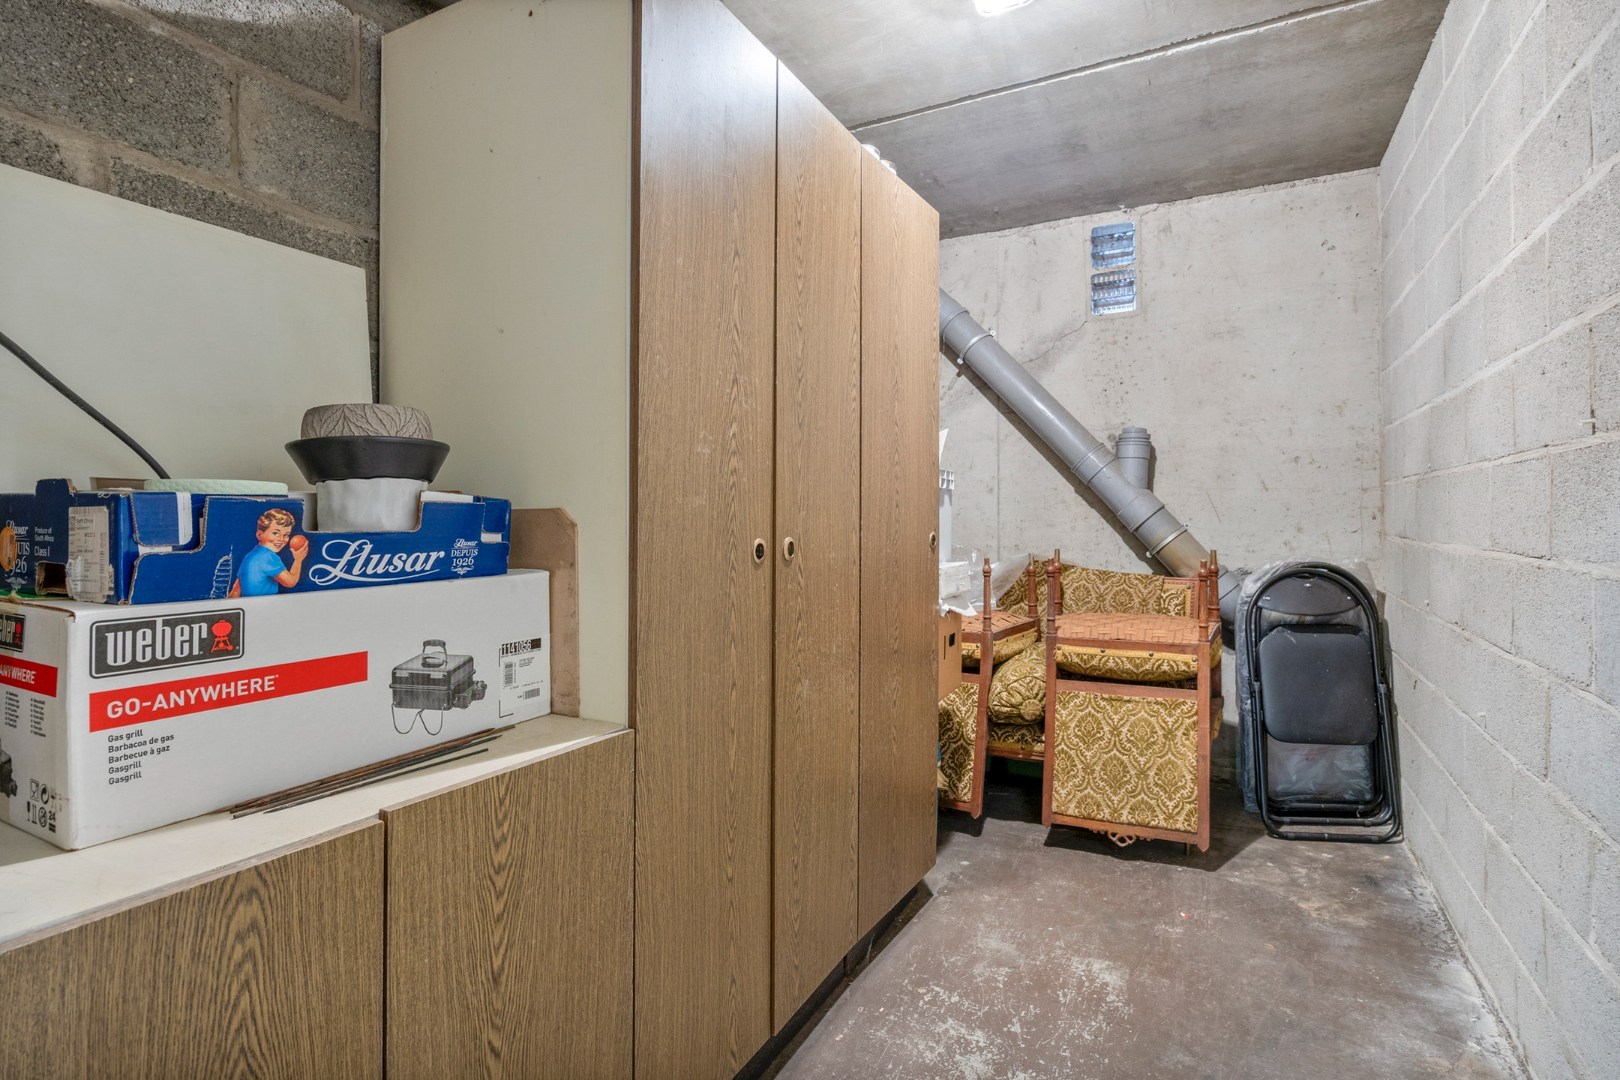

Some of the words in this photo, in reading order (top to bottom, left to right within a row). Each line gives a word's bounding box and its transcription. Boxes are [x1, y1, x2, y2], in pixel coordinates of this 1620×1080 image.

[17, 542, 30, 555] UIS
[34, 545, 47, 557] Class
[453, 538, 478, 549] Llusar
[451, 548, 479, 557] DEPUIS
[309, 539, 445, 586] Llusar
[452, 556, 474, 568] 1926
[105, 618, 208, 667] weber
[501, 639, 531, 656] 1141056
[0, 663, 36, 685] ANYWHERE
[107, 674, 276, 719] GO-ANYWHERE
[108, 734, 124, 743] Gas
[125, 729, 143, 741] grill
[108, 740, 147, 753] Barbacoa
[148, 736, 159, 745] de
[160, 734, 174, 744] gas
[108, 750, 148, 764] Barbecue
[149, 746, 155, 755] à
[156, 745, 170, 755] gaz
[108, 760, 142, 774] Gasgrill
[108, 770, 142, 785] Gasgrill
